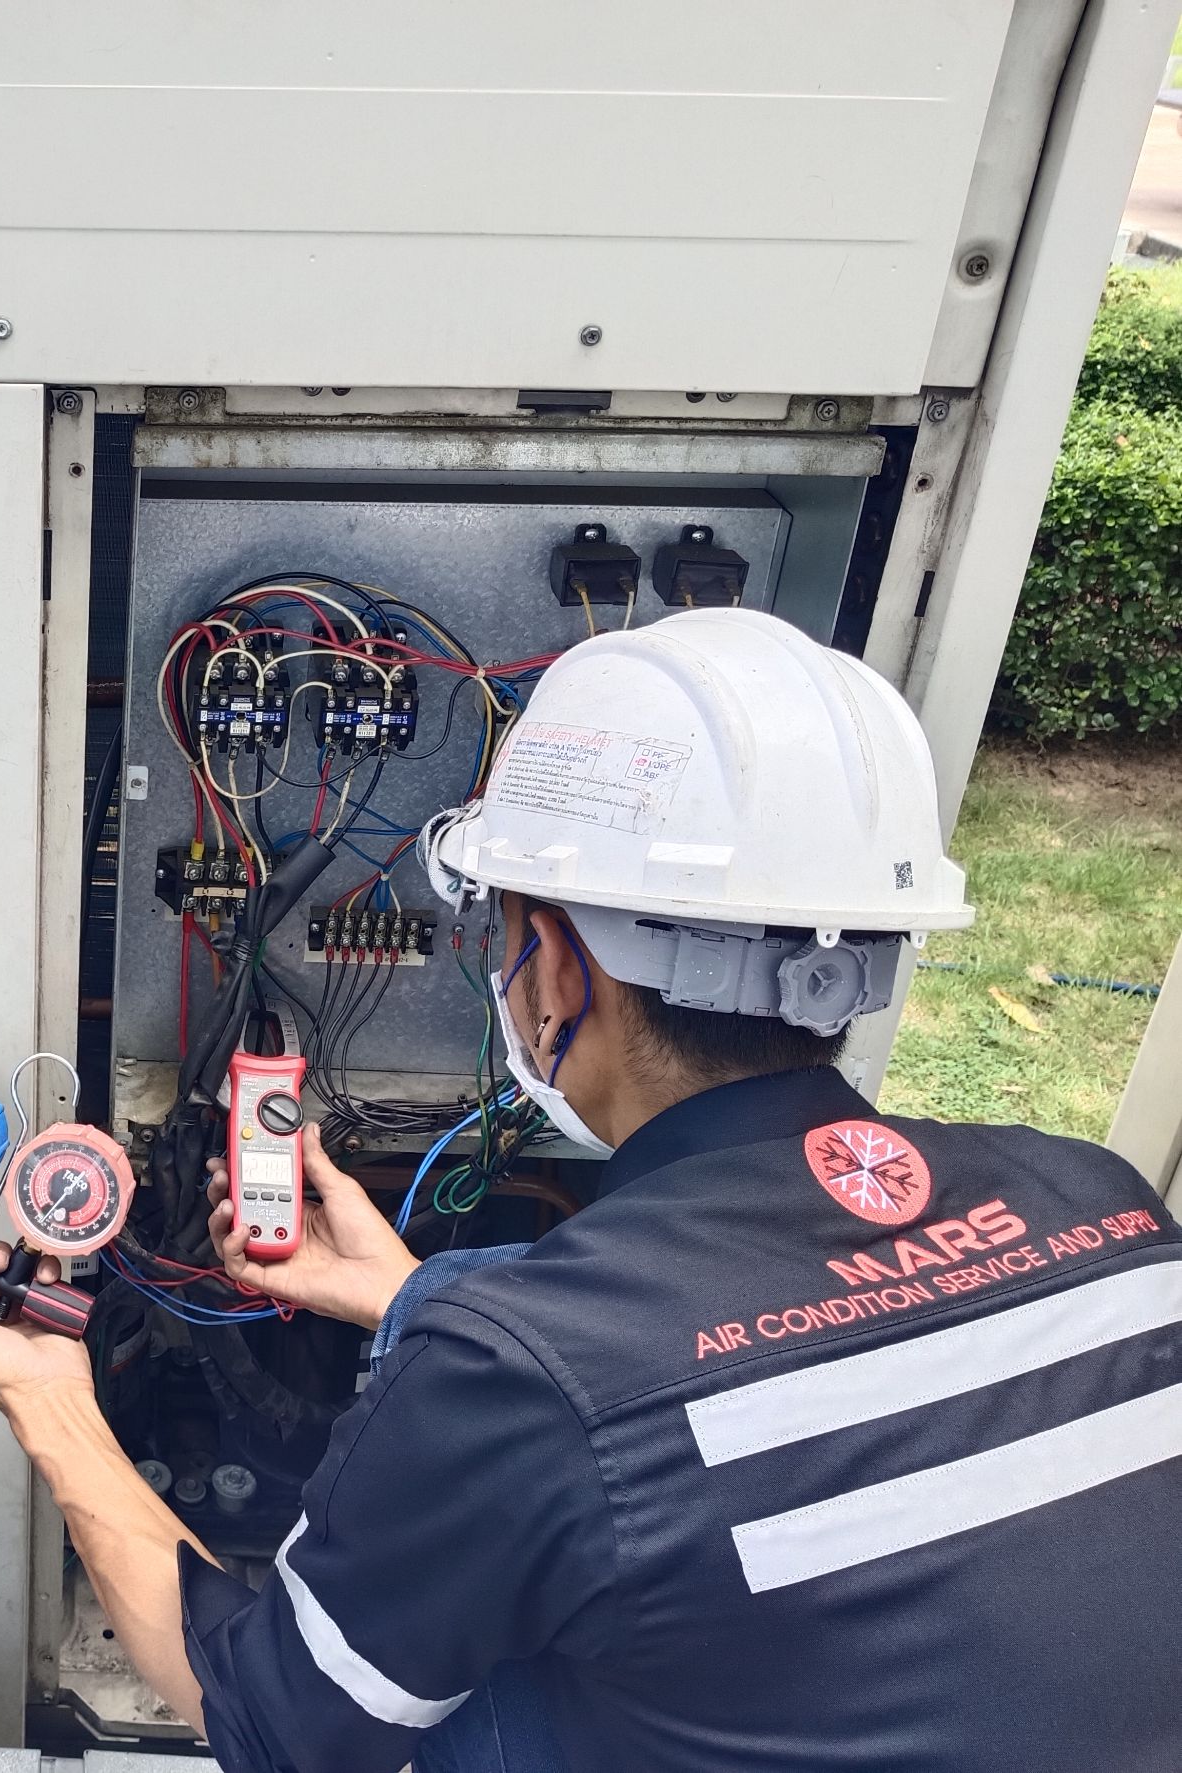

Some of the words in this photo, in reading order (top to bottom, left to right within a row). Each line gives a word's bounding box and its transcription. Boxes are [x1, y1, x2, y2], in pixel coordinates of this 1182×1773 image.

[62, 1169, 87, 1191] TASCO
[826, 1199, 1027, 1286] MARS
[696, 1322, 753, 1360] AIR
[756, 1282, 936, 1339] CONDITION
[932, 1245, 1048, 1295] SERVICE
[1046, 1225, 1104, 1260] AND
